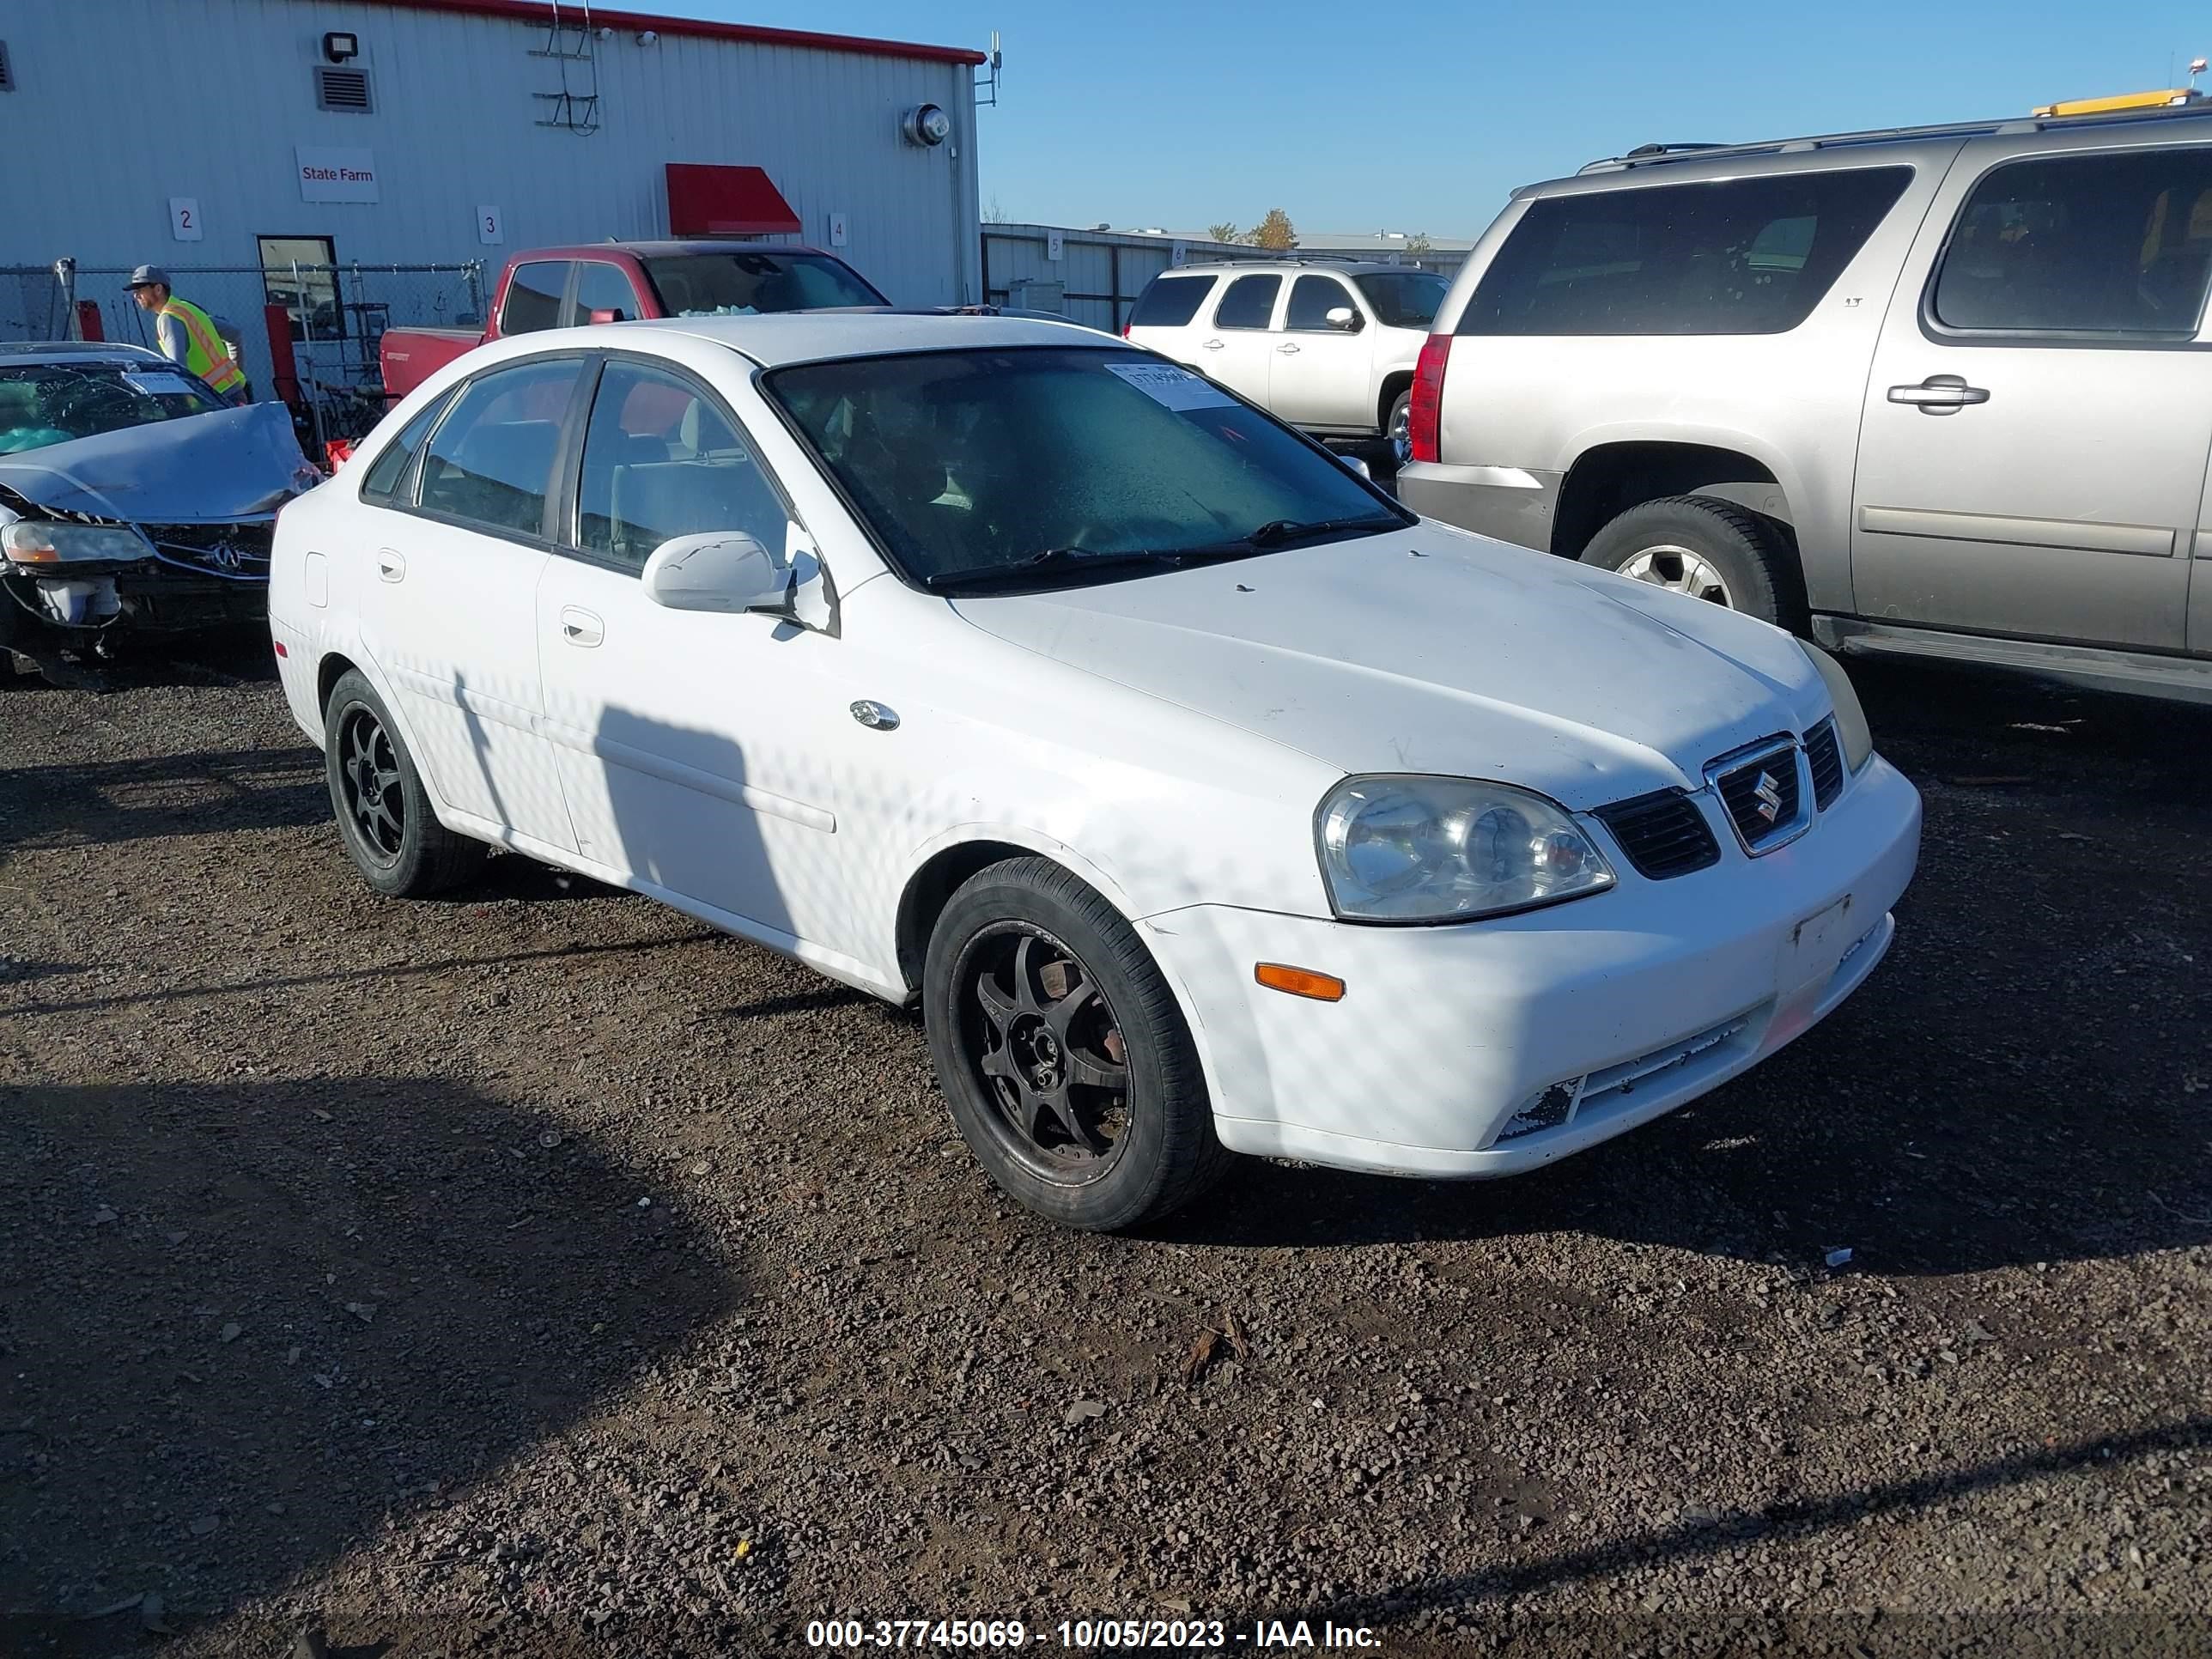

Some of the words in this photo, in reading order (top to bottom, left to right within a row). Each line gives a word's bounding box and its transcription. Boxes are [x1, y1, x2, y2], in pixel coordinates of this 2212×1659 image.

[302, 167, 337, 180] State
[340, 168, 374, 182] Farm
[180, 210, 193, 228] 2
[486, 216, 495, 234] 3
[836, 222, 842, 238] 4
[1052, 238, 1059, 252] 5
[1176, 247, 1182, 260] 6
